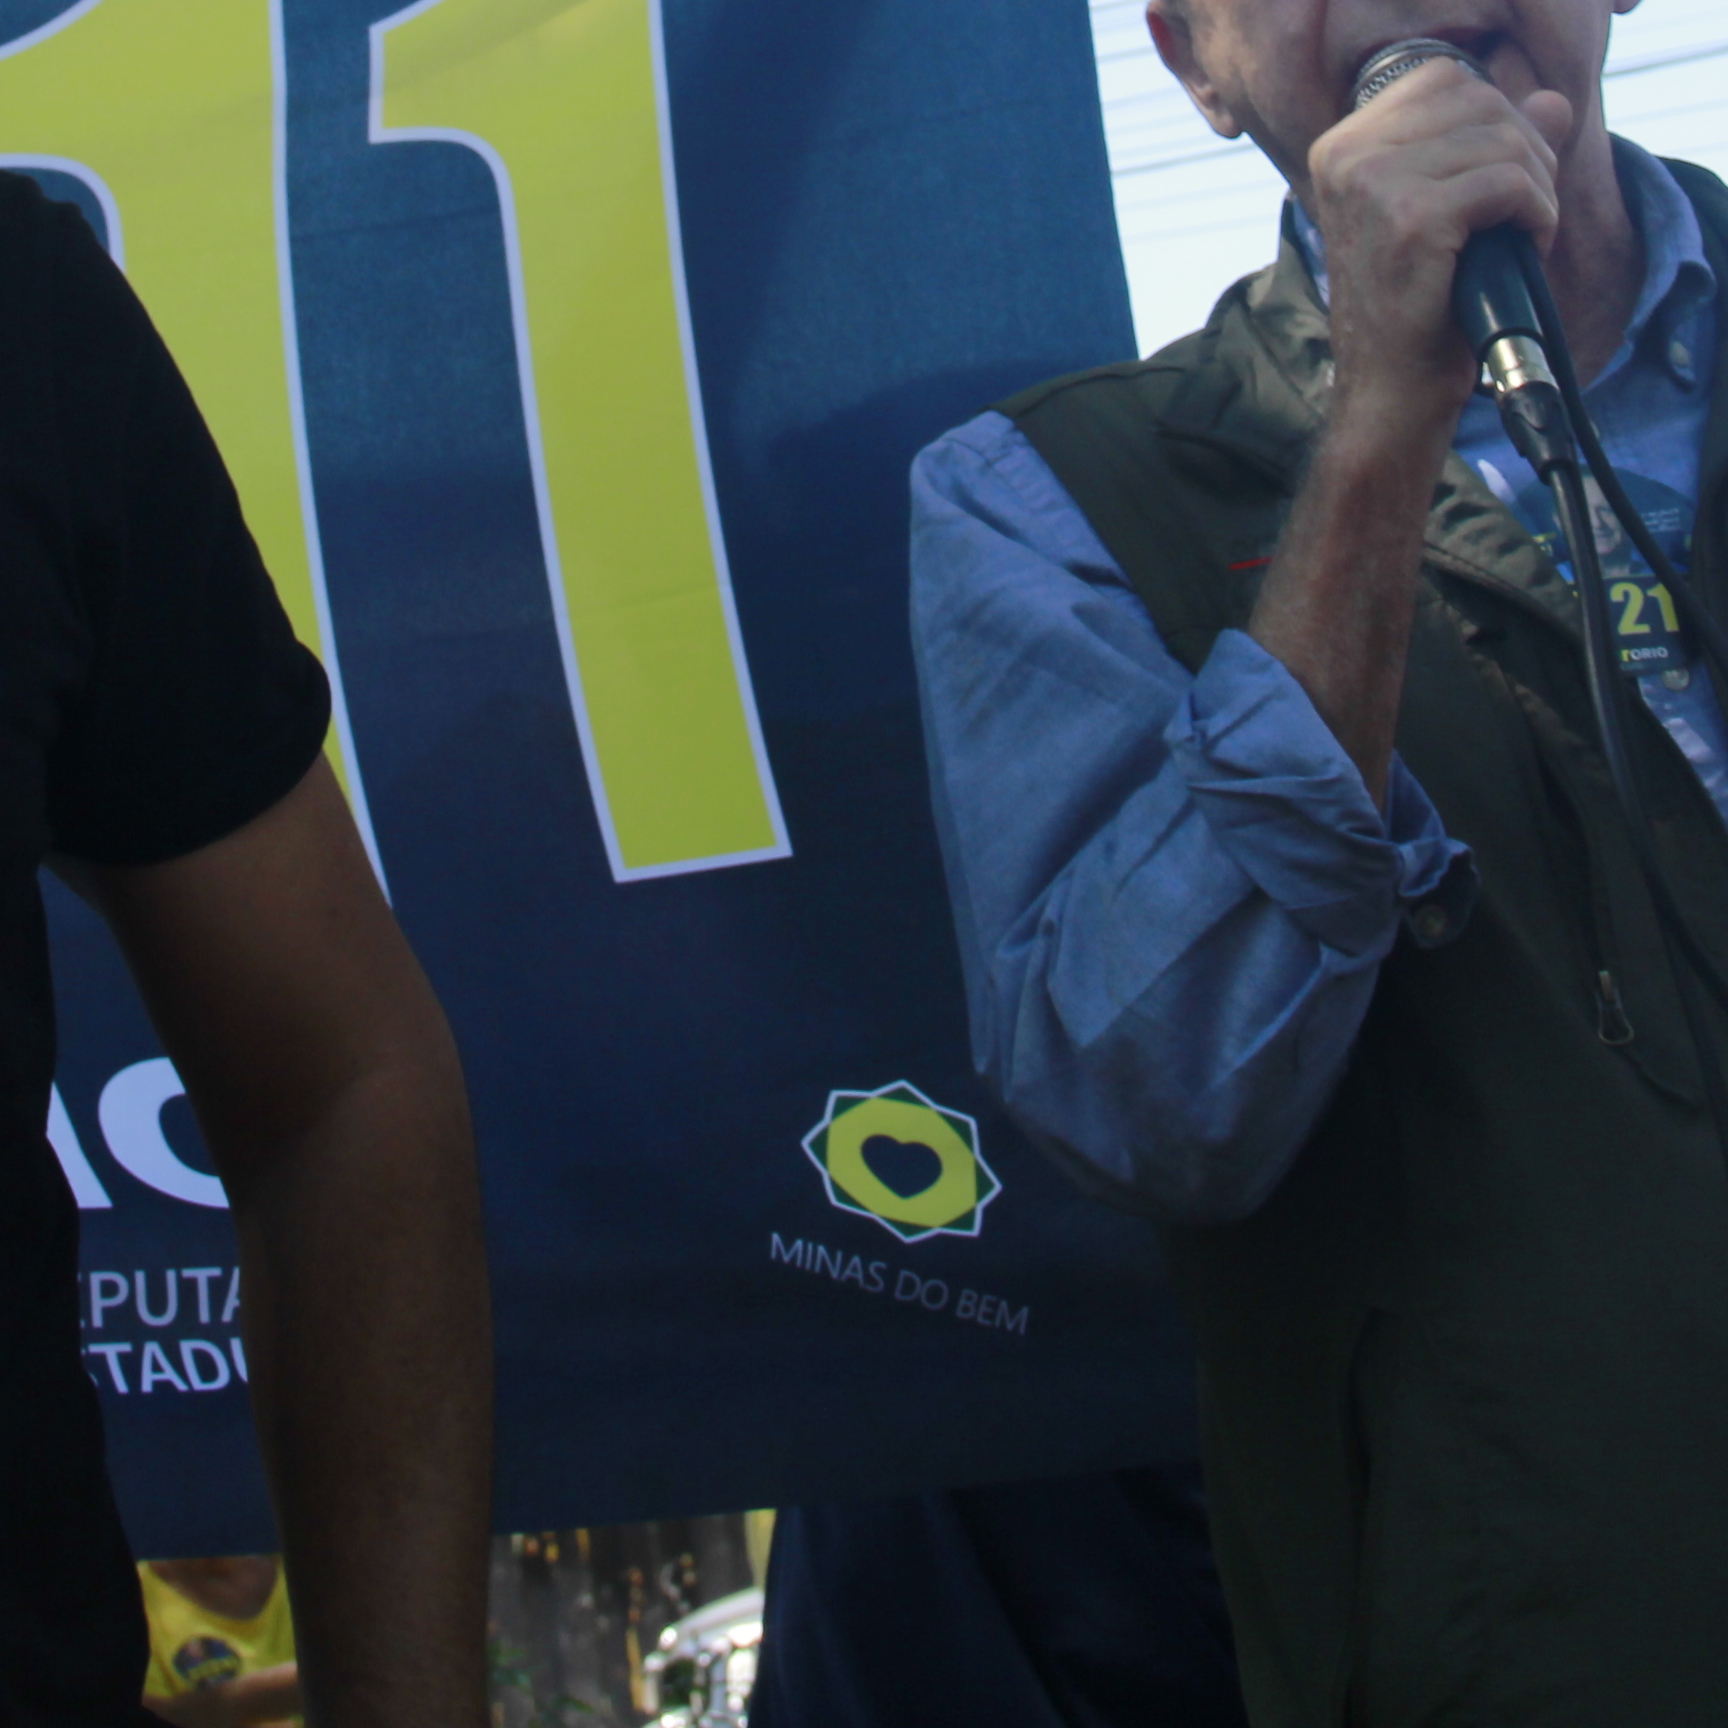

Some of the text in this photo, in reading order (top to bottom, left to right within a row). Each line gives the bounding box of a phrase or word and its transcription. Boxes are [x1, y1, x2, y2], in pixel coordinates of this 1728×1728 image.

[770, 1231, 1029, 1336] MINAS DO BEM
